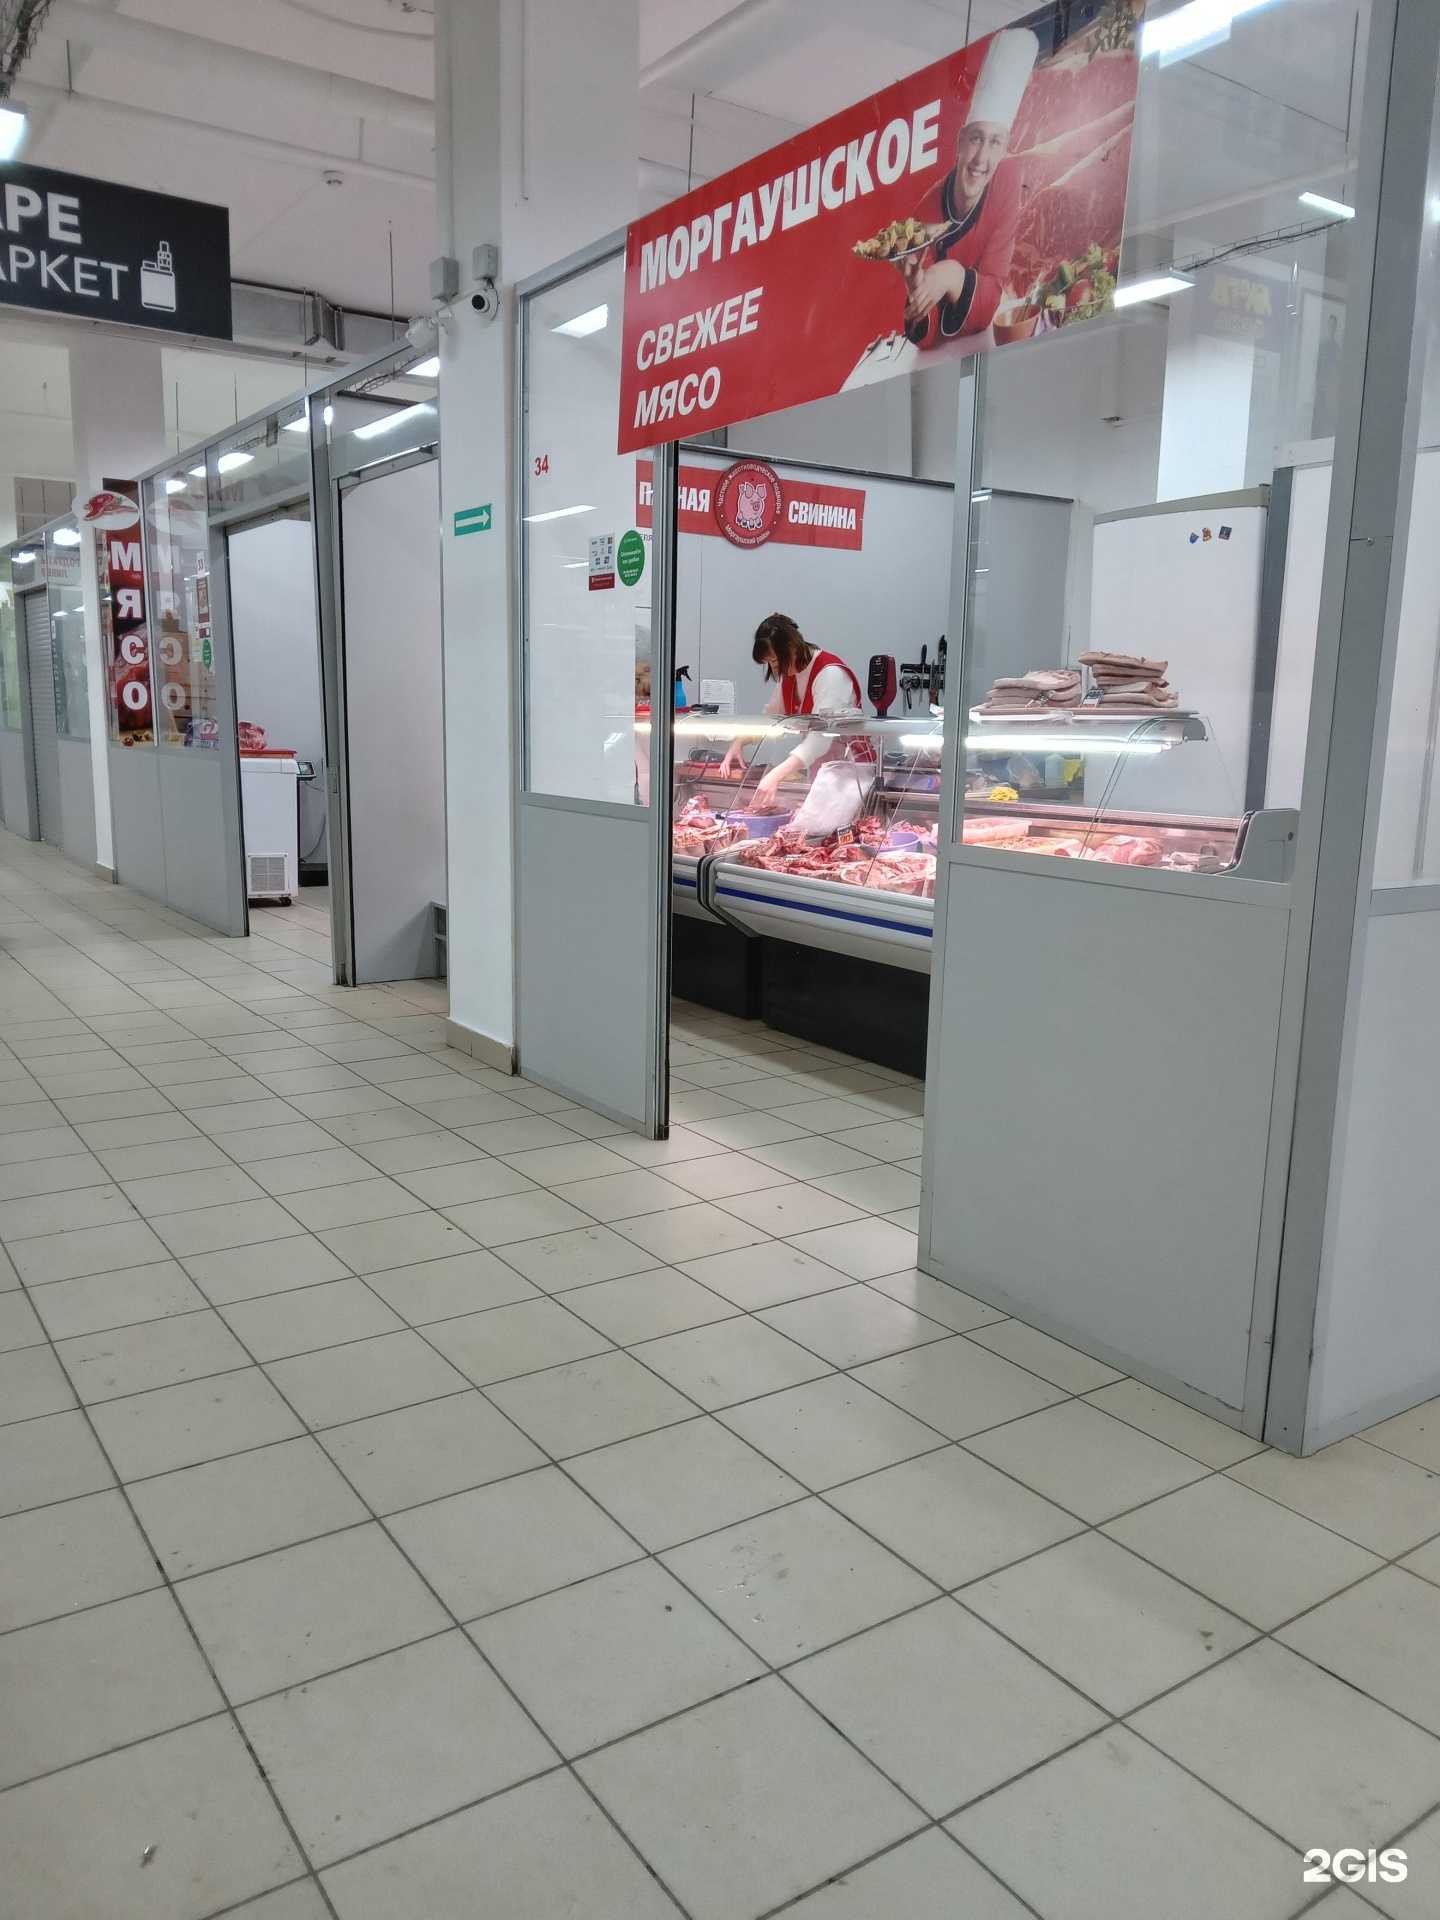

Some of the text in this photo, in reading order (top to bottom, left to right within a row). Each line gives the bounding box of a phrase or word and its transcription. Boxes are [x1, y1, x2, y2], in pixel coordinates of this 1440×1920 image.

[0, 184, 82, 244] PE
[640, 99, 940, 294] МОРГАУШСКОЕ
[636, 286, 764, 371] СВЕЖЕЕ
[633, 366, 721, 429] МЯСО
[534, 454, 549, 476] 34
[638, 481, 857, 530] ПНАЯ СВИНИНА
[110, 541, 149, 711] МЯСО
